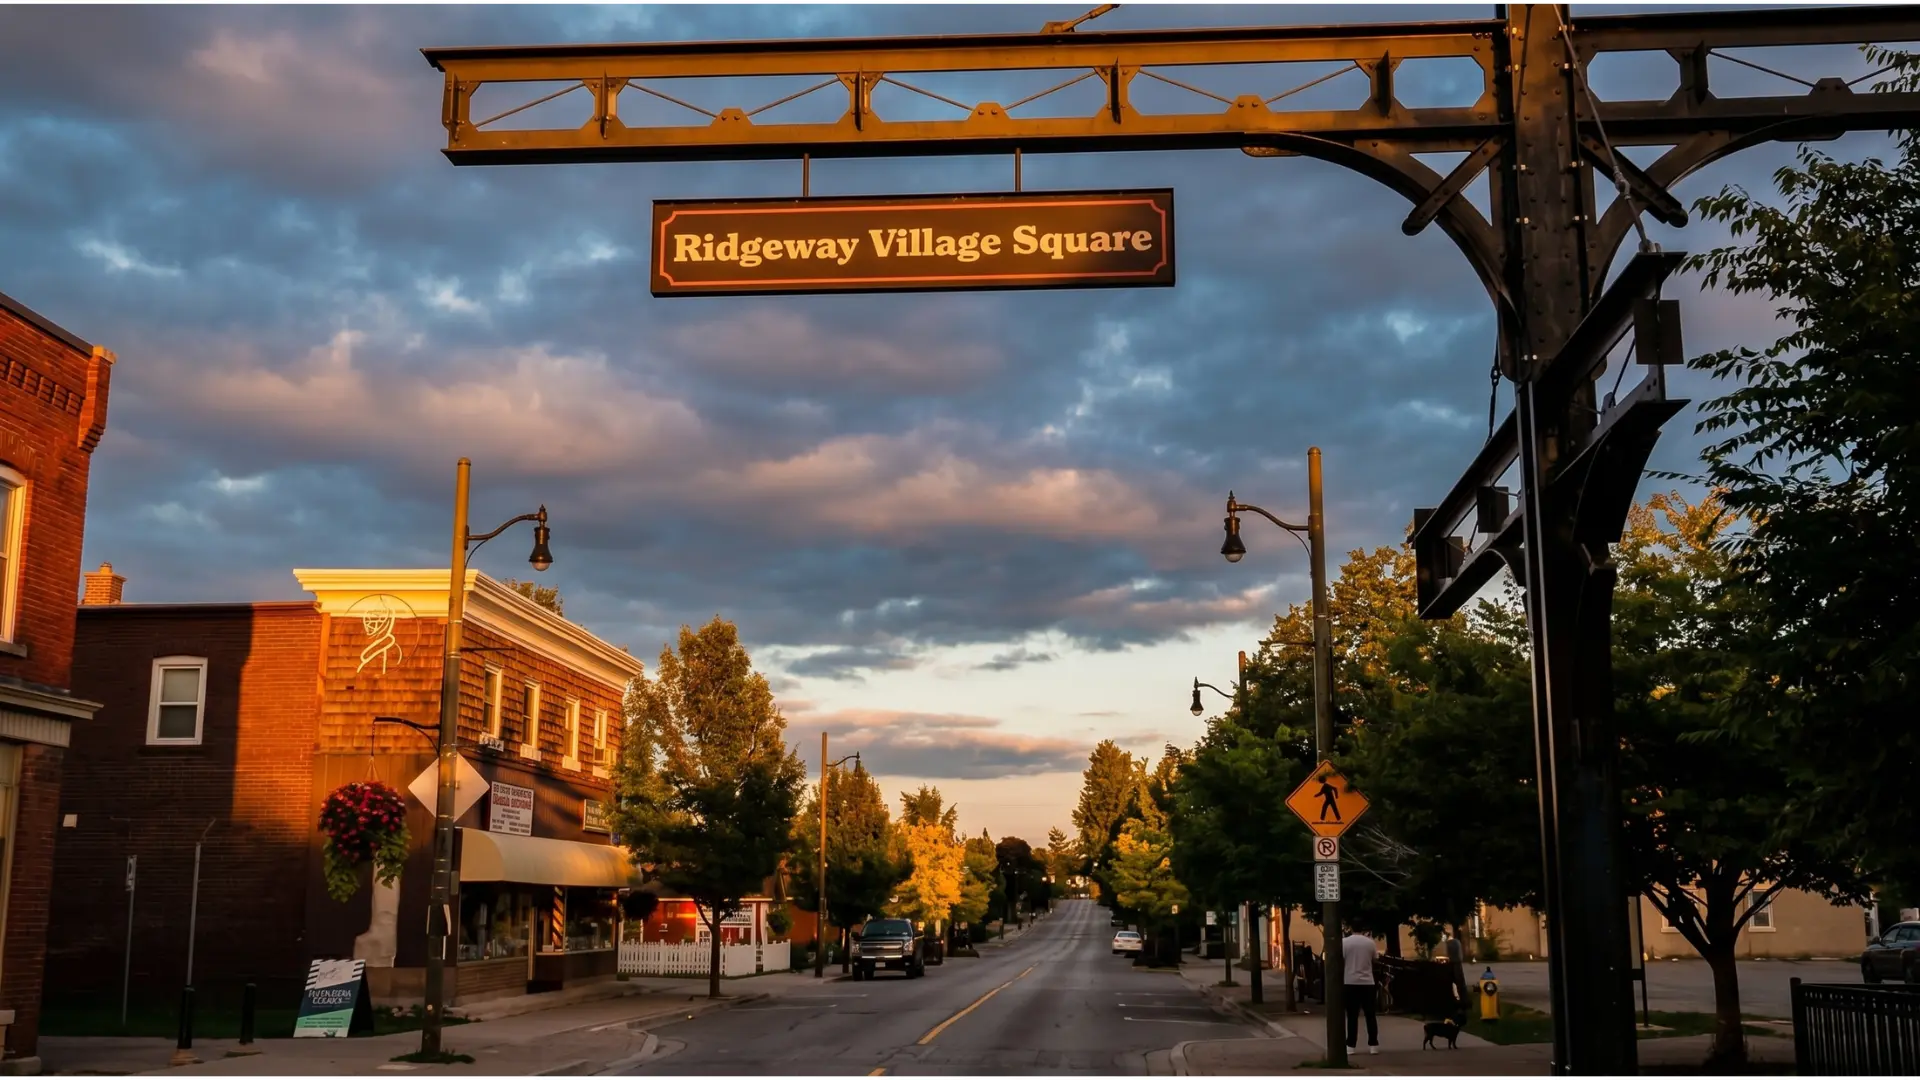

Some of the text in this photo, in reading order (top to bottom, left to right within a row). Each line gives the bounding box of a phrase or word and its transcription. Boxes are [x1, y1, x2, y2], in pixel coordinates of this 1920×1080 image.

[673, 224, 1152, 268] Ridgeway Village Square
